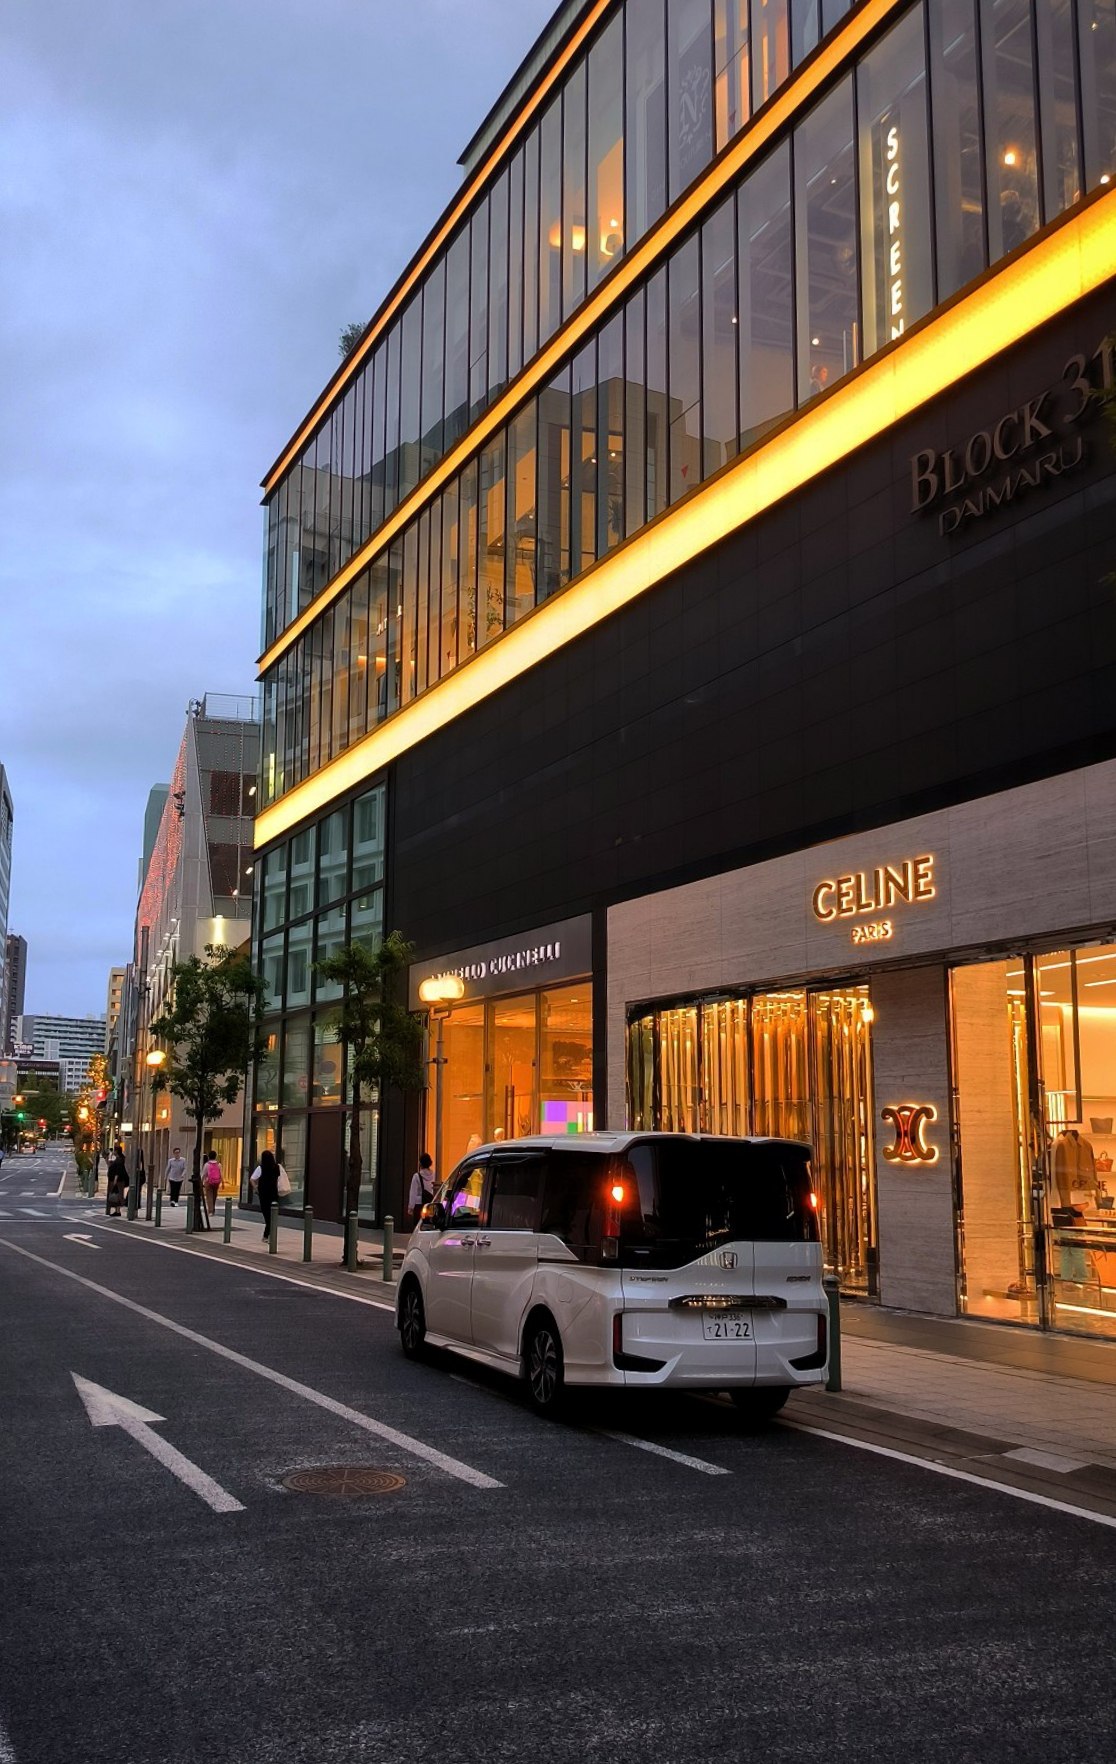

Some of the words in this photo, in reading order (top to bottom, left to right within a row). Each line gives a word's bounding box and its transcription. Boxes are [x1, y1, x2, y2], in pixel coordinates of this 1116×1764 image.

[886, 127, 905, 341] SCREEN
[910, 390, 1053, 514] BLOCK
[1061, 335, 1116, 425] 31
[938, 437, 1082, 537] DAIMARU
[812, 855, 936, 921] CELINE
[850, 920, 893, 944] PARIS
[714, 1322, 750, 1338] 21-22
